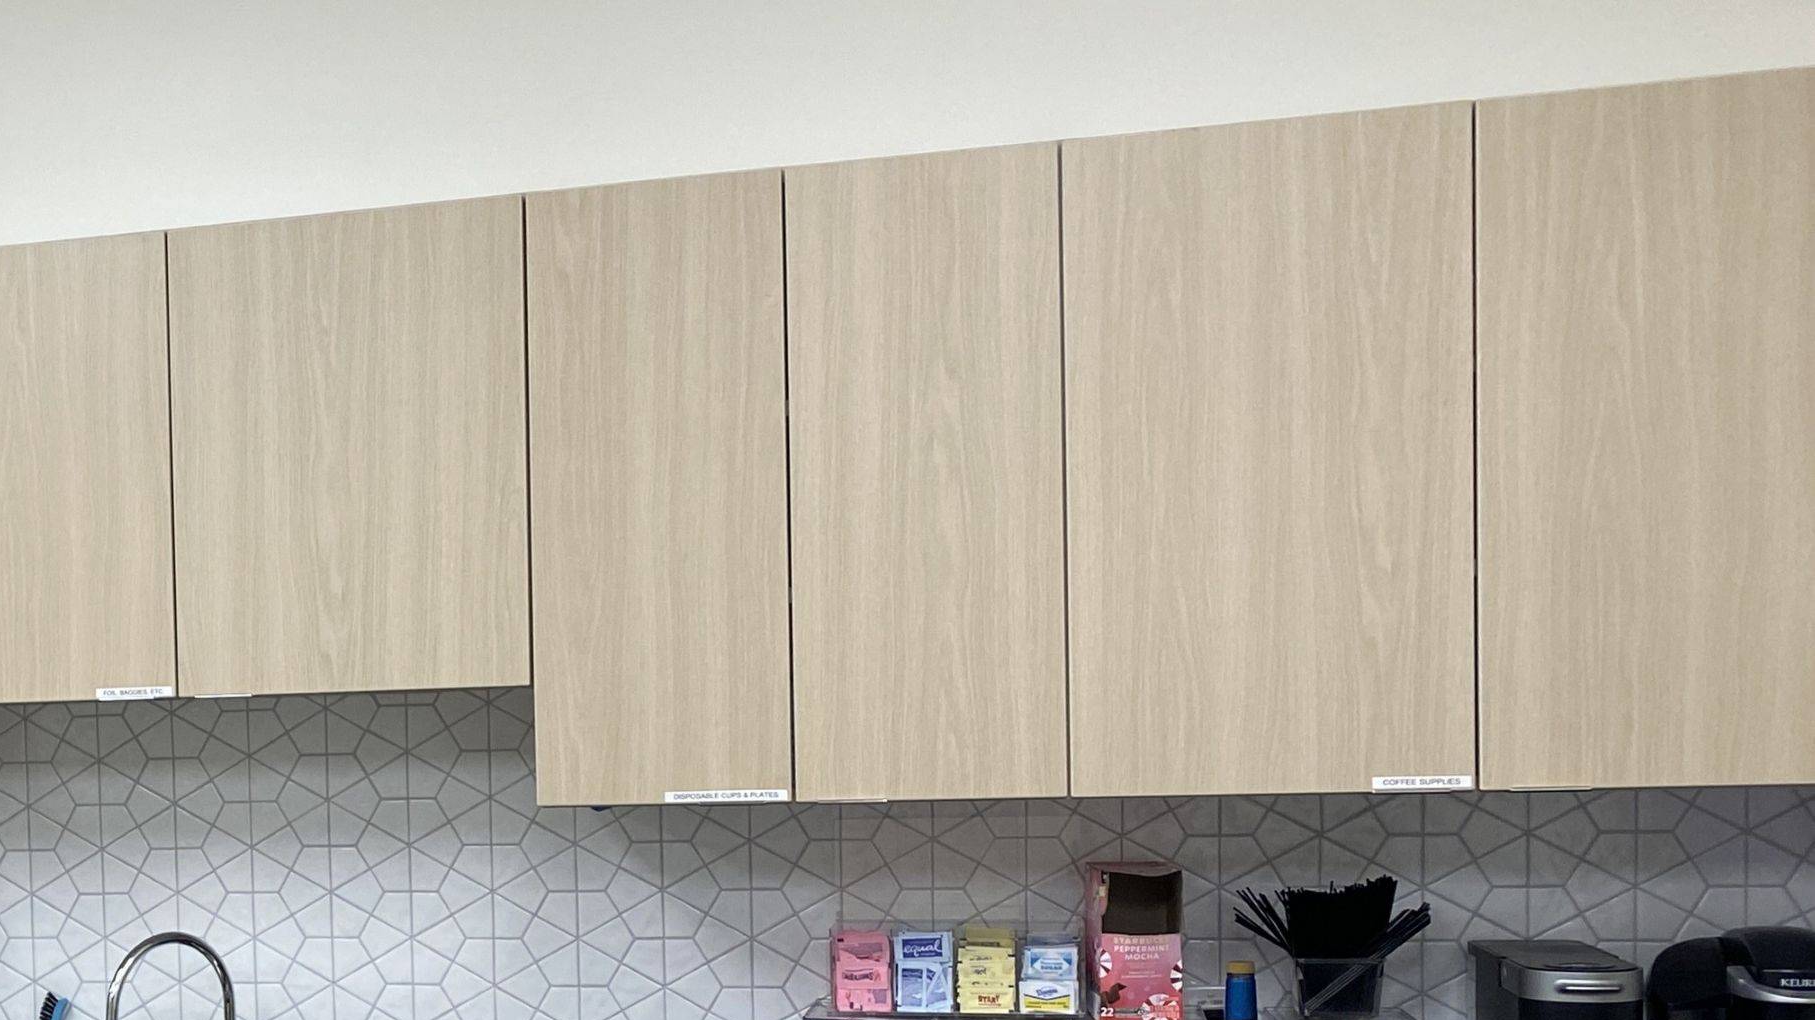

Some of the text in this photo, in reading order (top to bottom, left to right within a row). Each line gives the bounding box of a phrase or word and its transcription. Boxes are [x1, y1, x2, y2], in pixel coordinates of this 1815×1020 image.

[904, 939, 942, 957] equal
[1113, 944, 1170, 953] PEPPERMINT
[1125, 952, 1160, 961] MOCHA
[1100, 1007, 1114, 1017] 22
